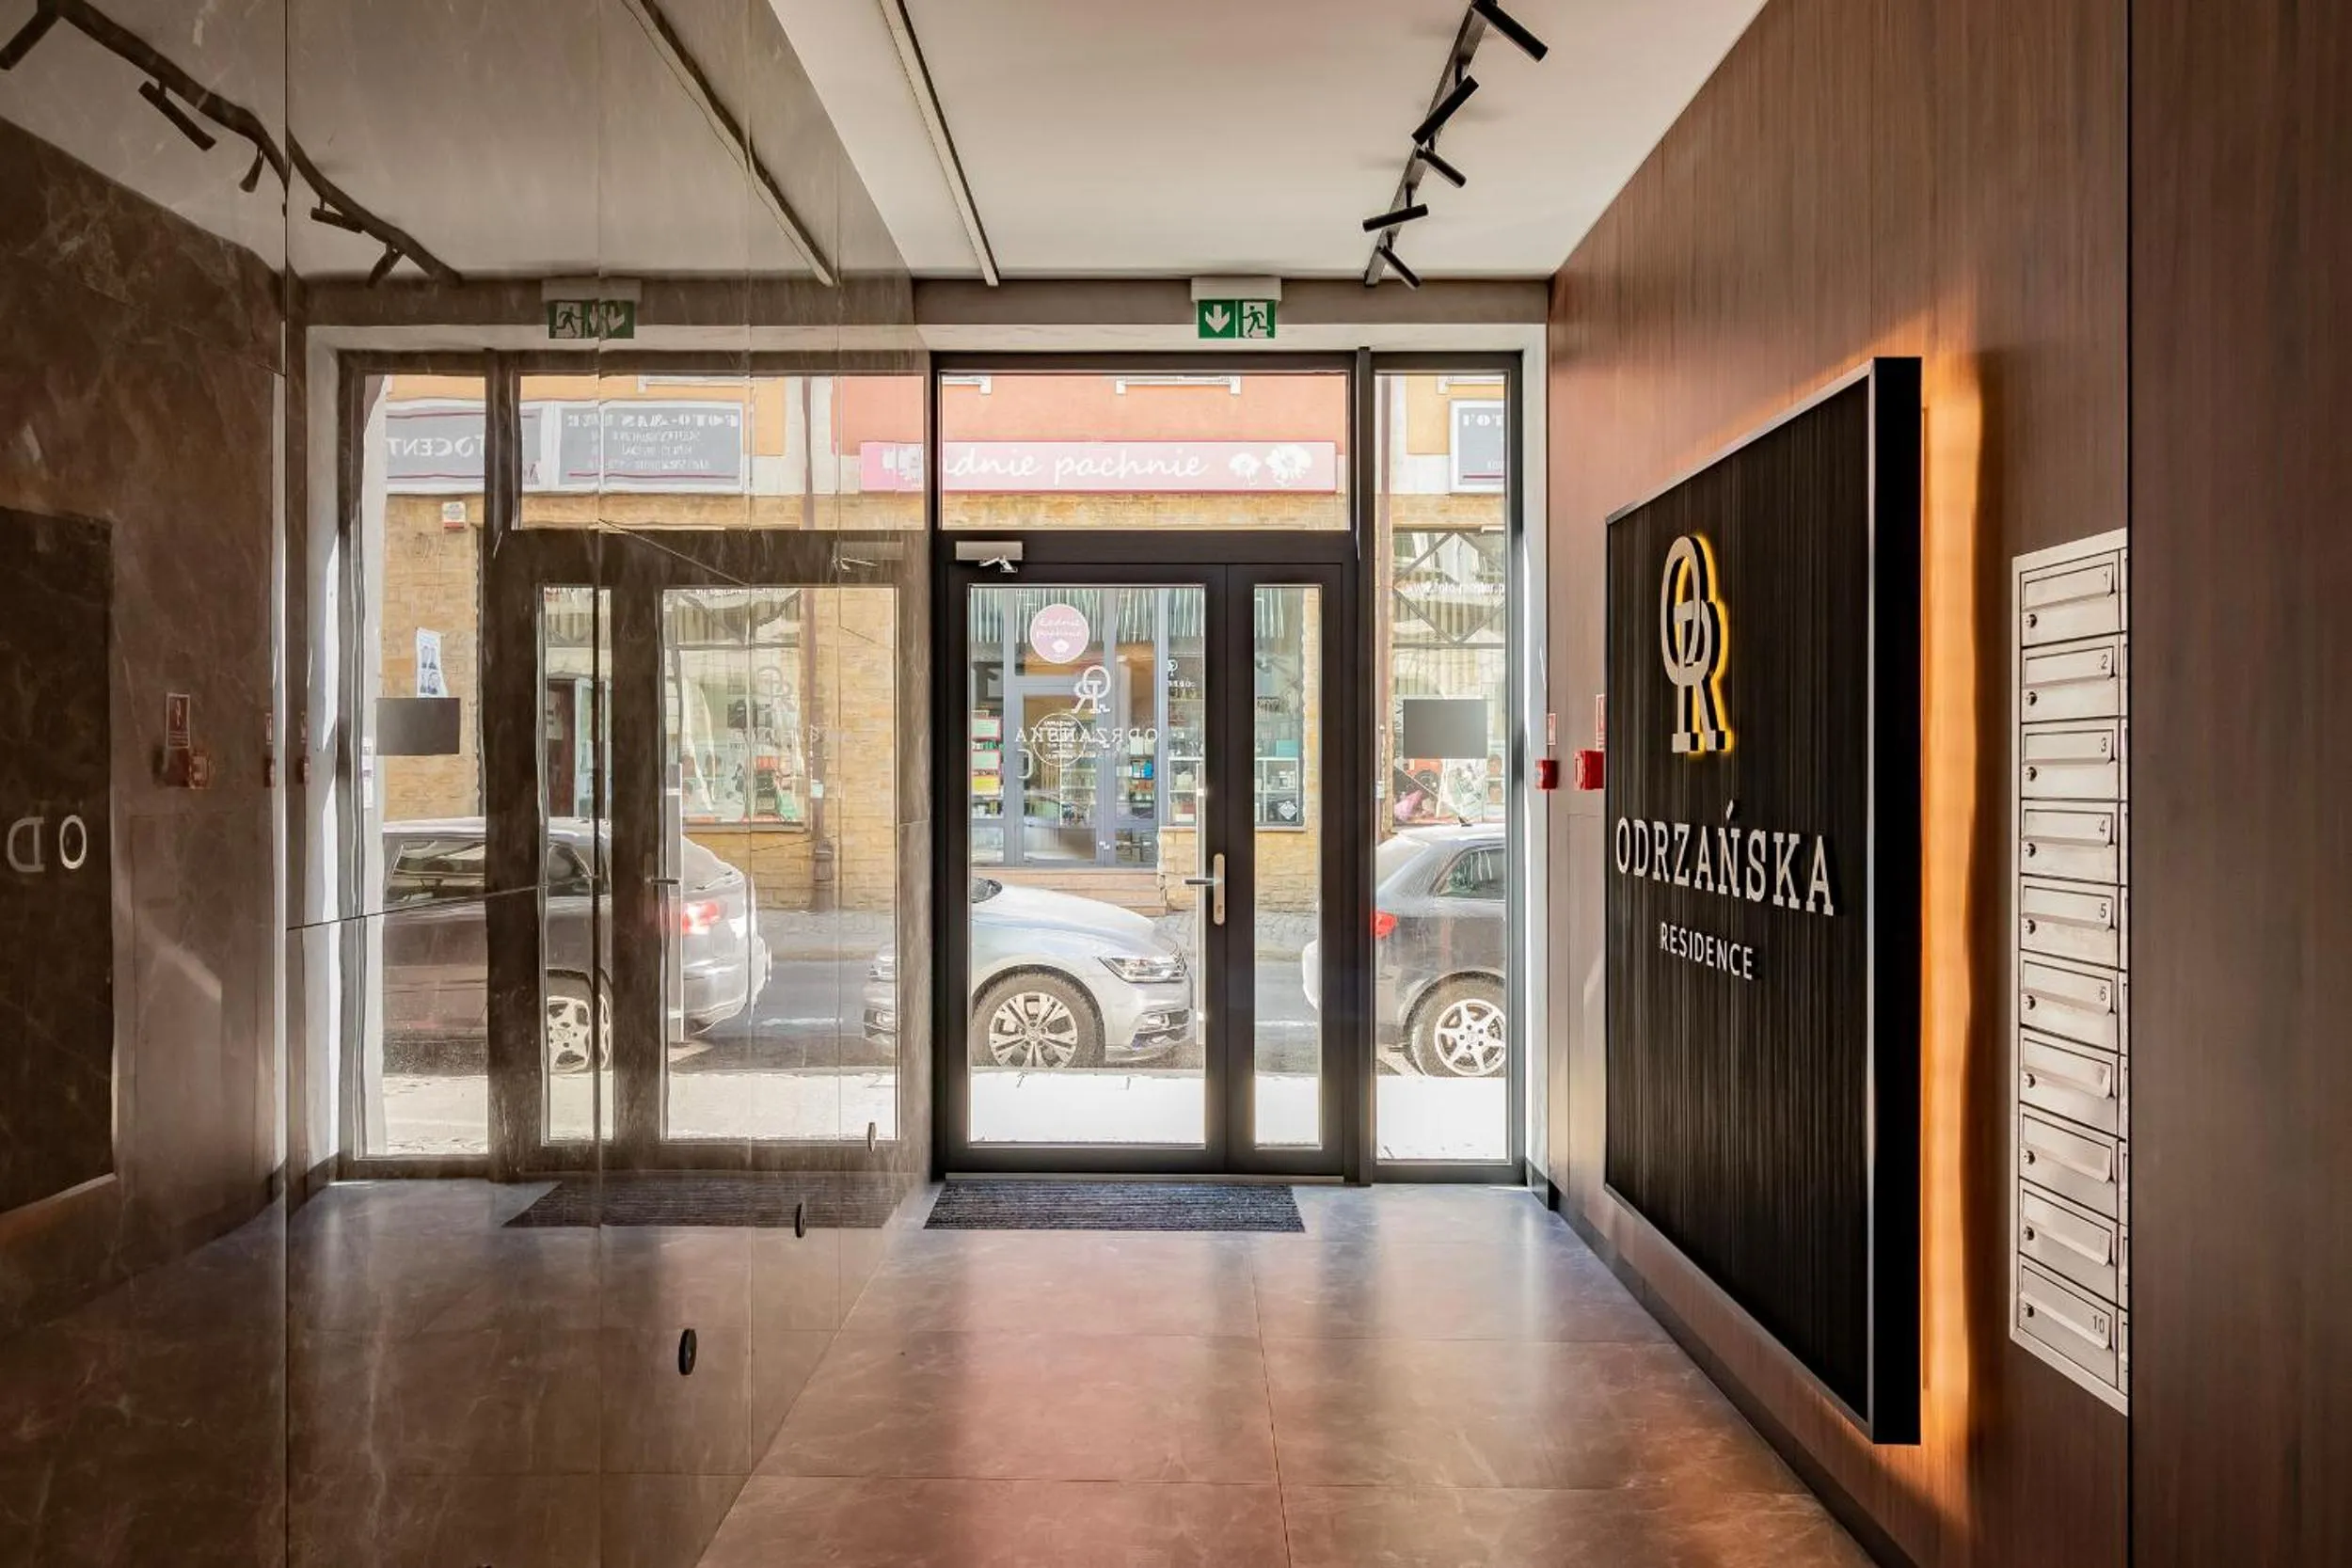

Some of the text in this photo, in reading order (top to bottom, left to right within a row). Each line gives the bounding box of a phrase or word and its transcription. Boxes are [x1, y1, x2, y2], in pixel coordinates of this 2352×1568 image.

[1054, 446, 1209, 484] pachnie
[2100, 655, 2107, 669] 2
[2101, 737, 2107, 752] 3
[2099, 820, 2106, 835] 4
[1615, 800, 1834, 917] ODRZAŃSKA
[2100, 904, 2107, 918] 5
[1660, 922, 1754, 981] RESIDENCE
[2100, 986, 2107, 1001] 6
[2093, 1314, 2106, 1333] 10
